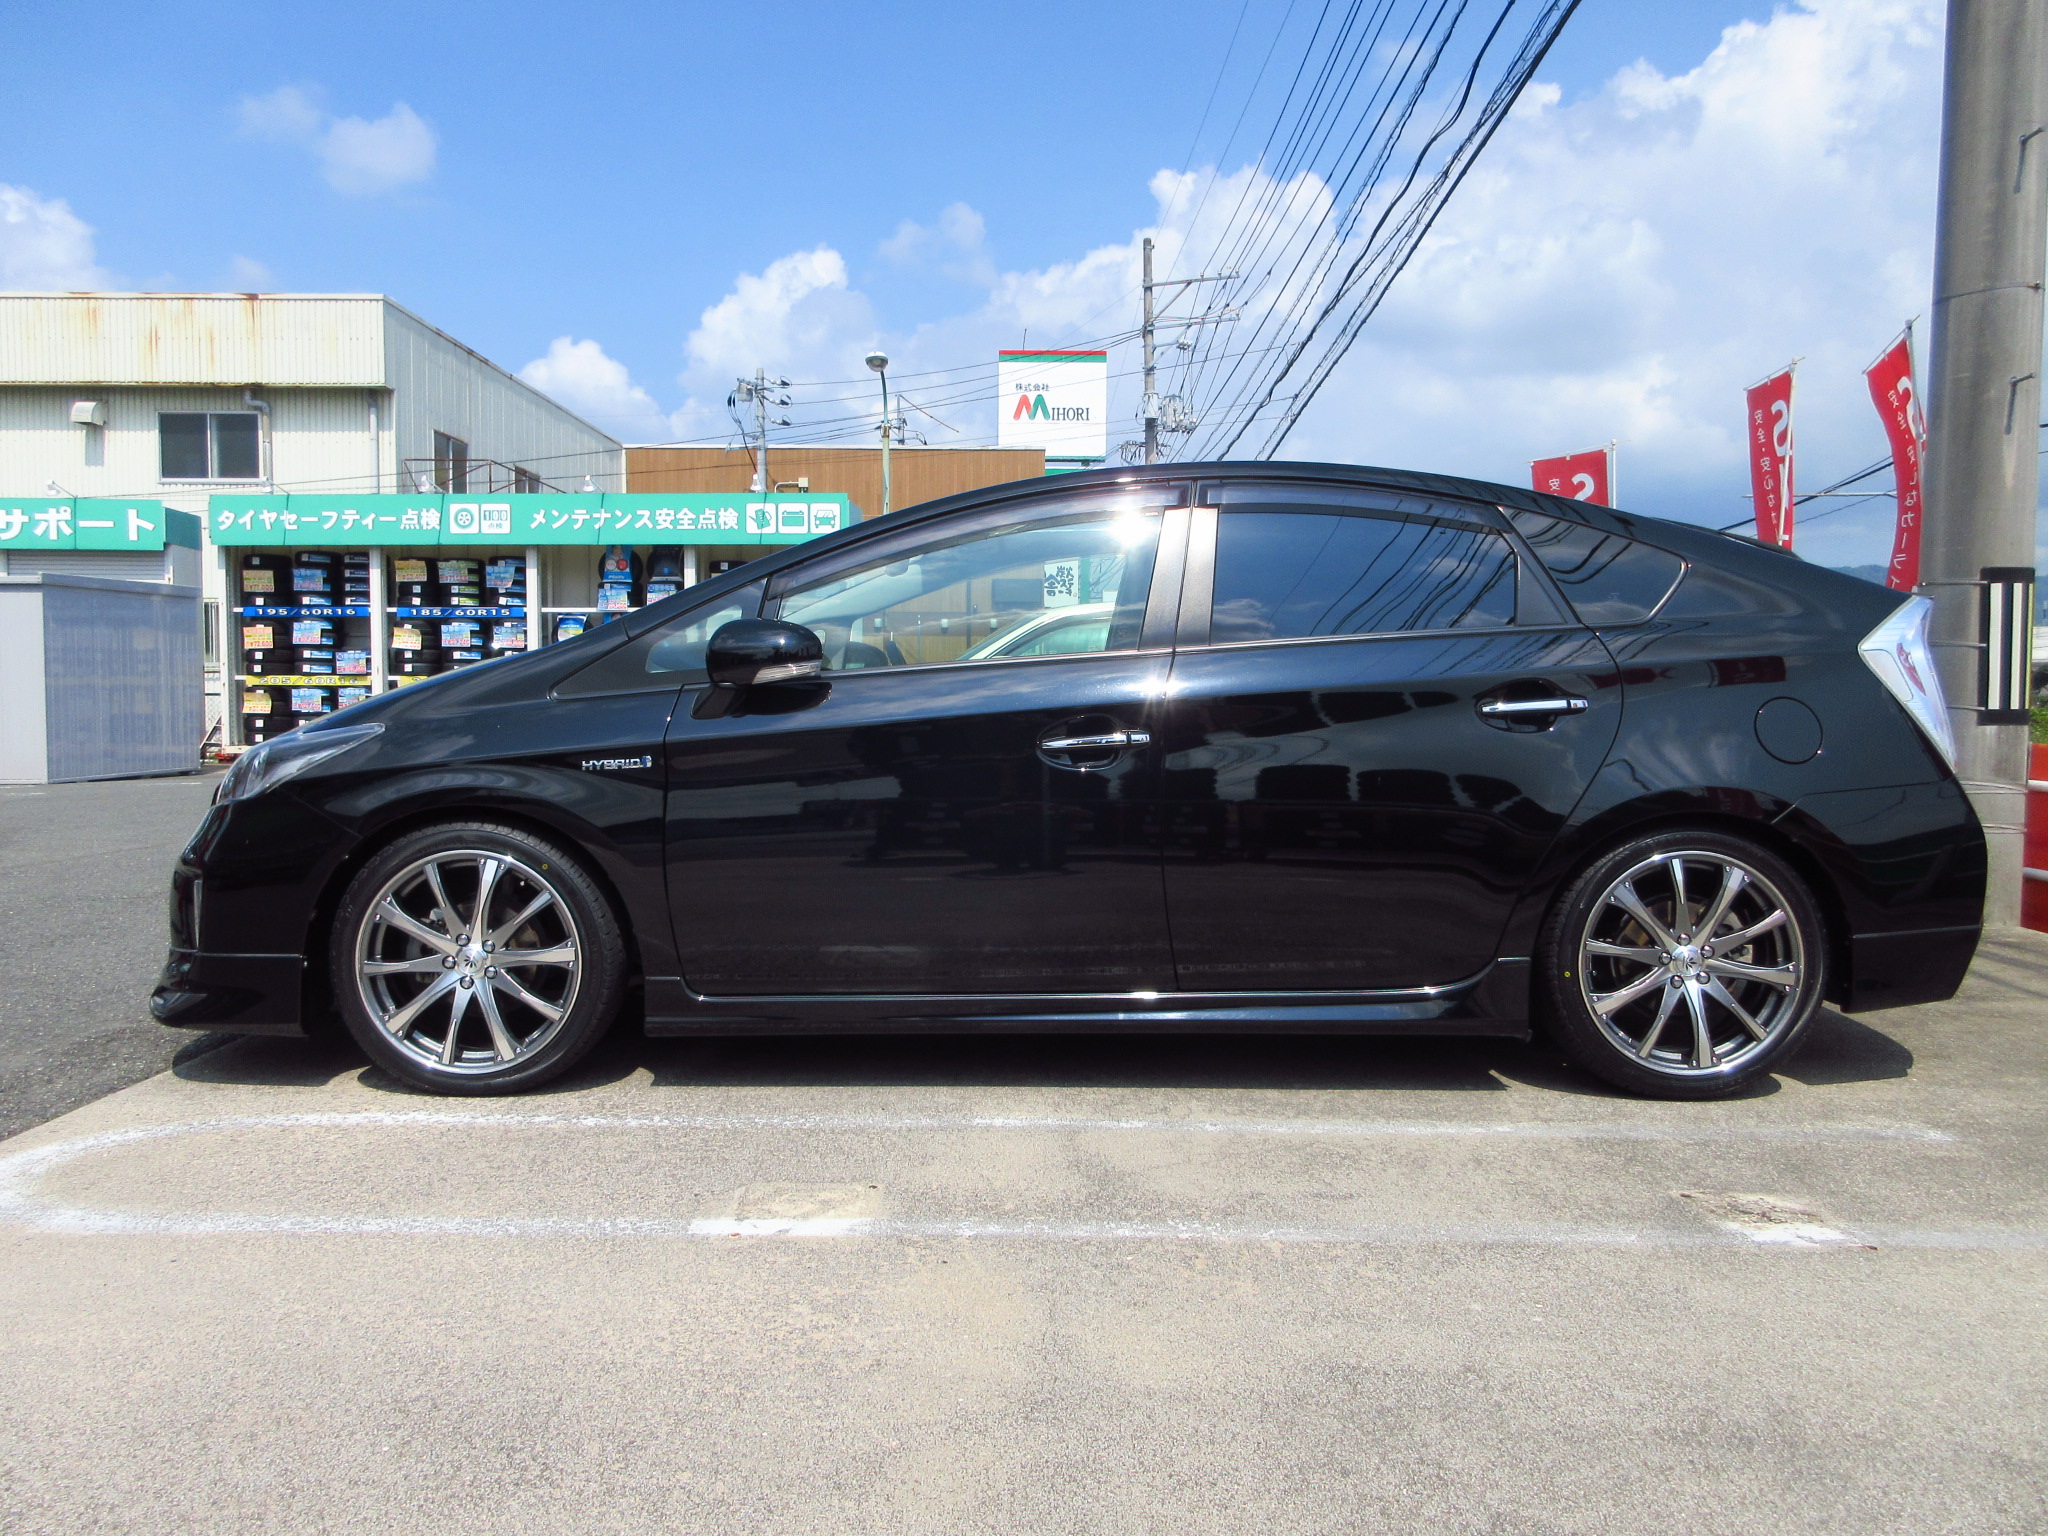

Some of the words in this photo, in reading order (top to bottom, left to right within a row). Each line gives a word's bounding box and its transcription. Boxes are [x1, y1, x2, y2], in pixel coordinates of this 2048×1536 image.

[1015, 383, 1050, 392] 株式会社
[1013, 394, 1090, 421] MIHORI
[0, 506, 156, 541] サポート
[217, 508, 441, 531] タイヤセーフティー点検
[530, 507, 739, 530] メンテナンス安全点検
[256, 608, 356, 616] 195/60R16
[410, 608, 511, 616] 185/60R15
[259, 677, 360, 685] 205/60R16
[582, 758, 641, 771] HYBRID
